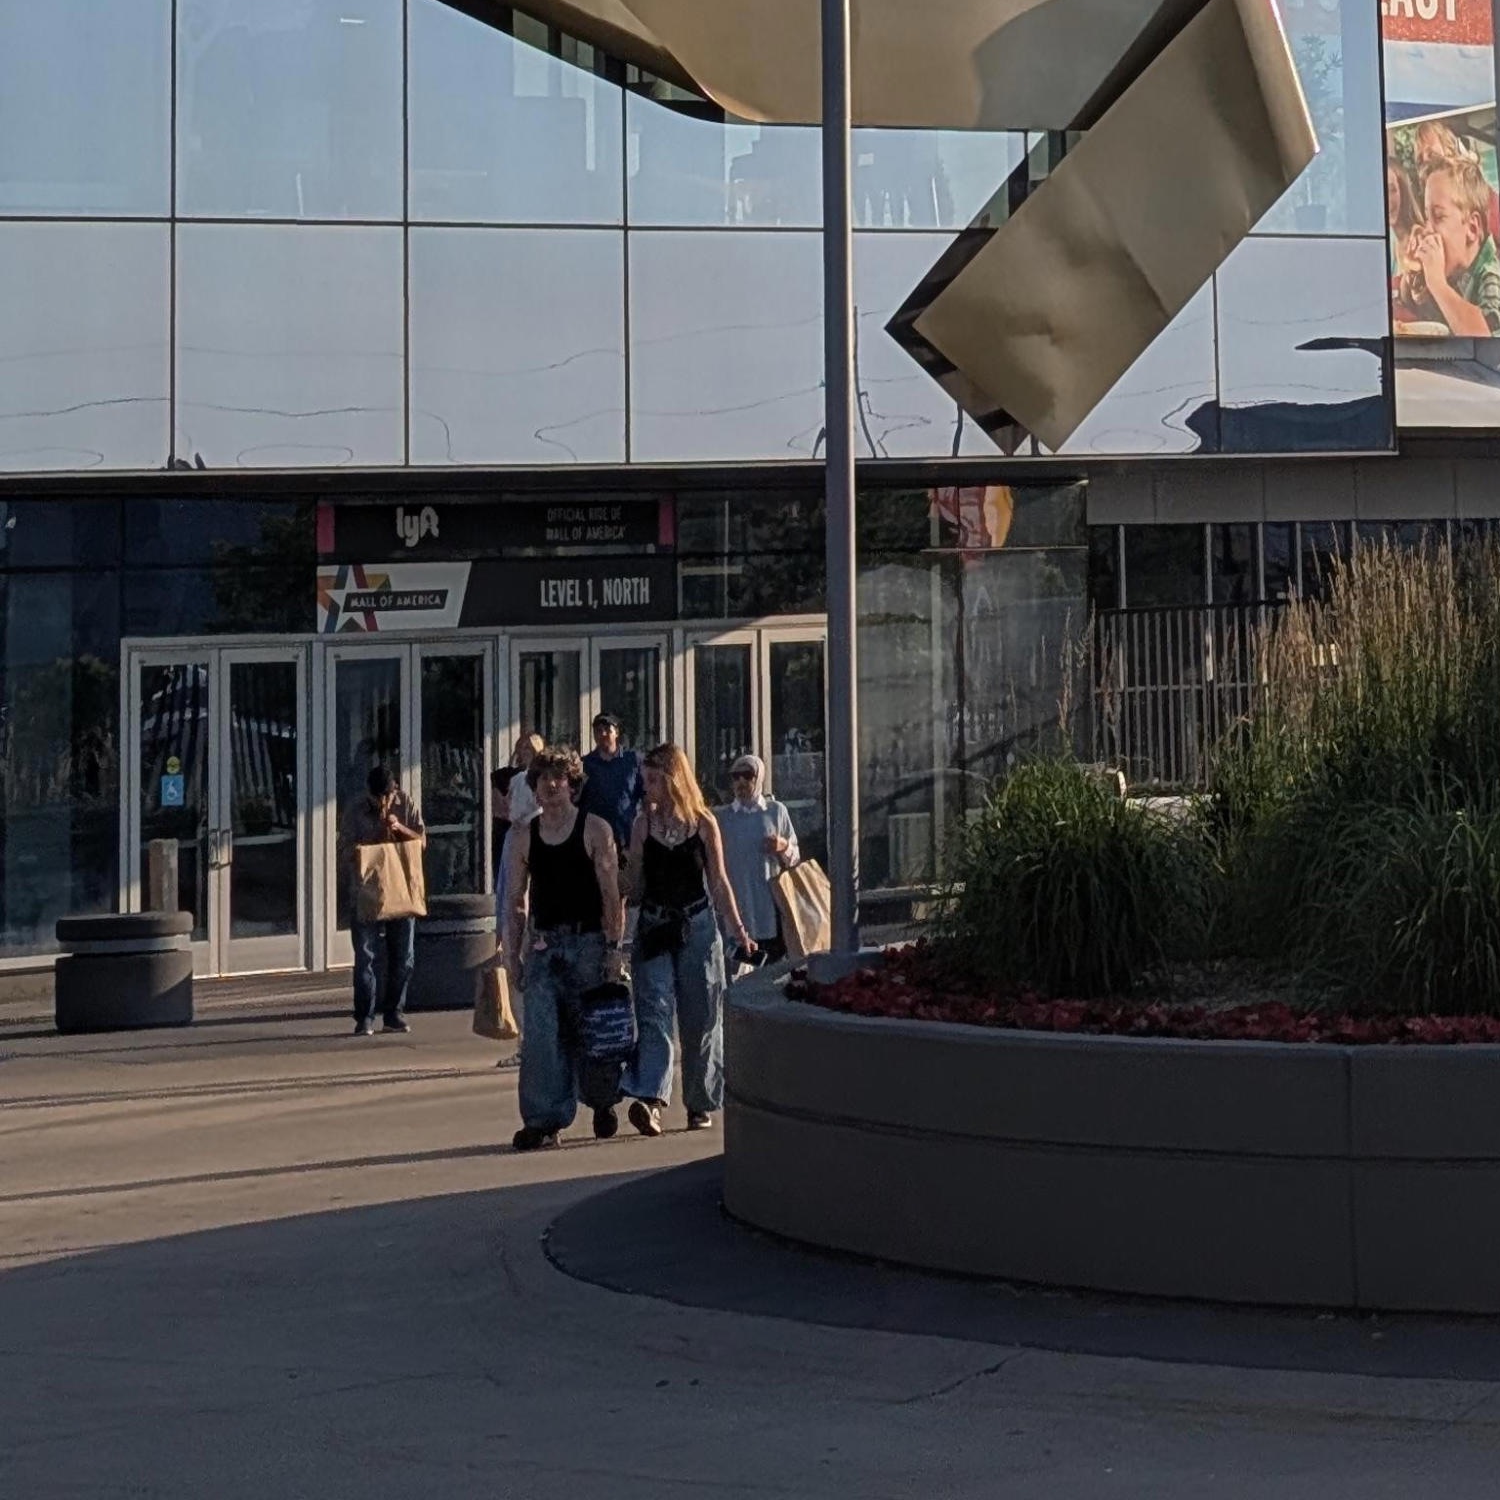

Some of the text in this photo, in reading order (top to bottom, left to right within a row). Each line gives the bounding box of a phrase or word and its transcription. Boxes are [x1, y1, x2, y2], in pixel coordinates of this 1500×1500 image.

[350, 594, 442, 608] MALL OF AMERICA
[540, 579, 584, 608] LEVEL
[603, 577, 650, 606] NORTH
